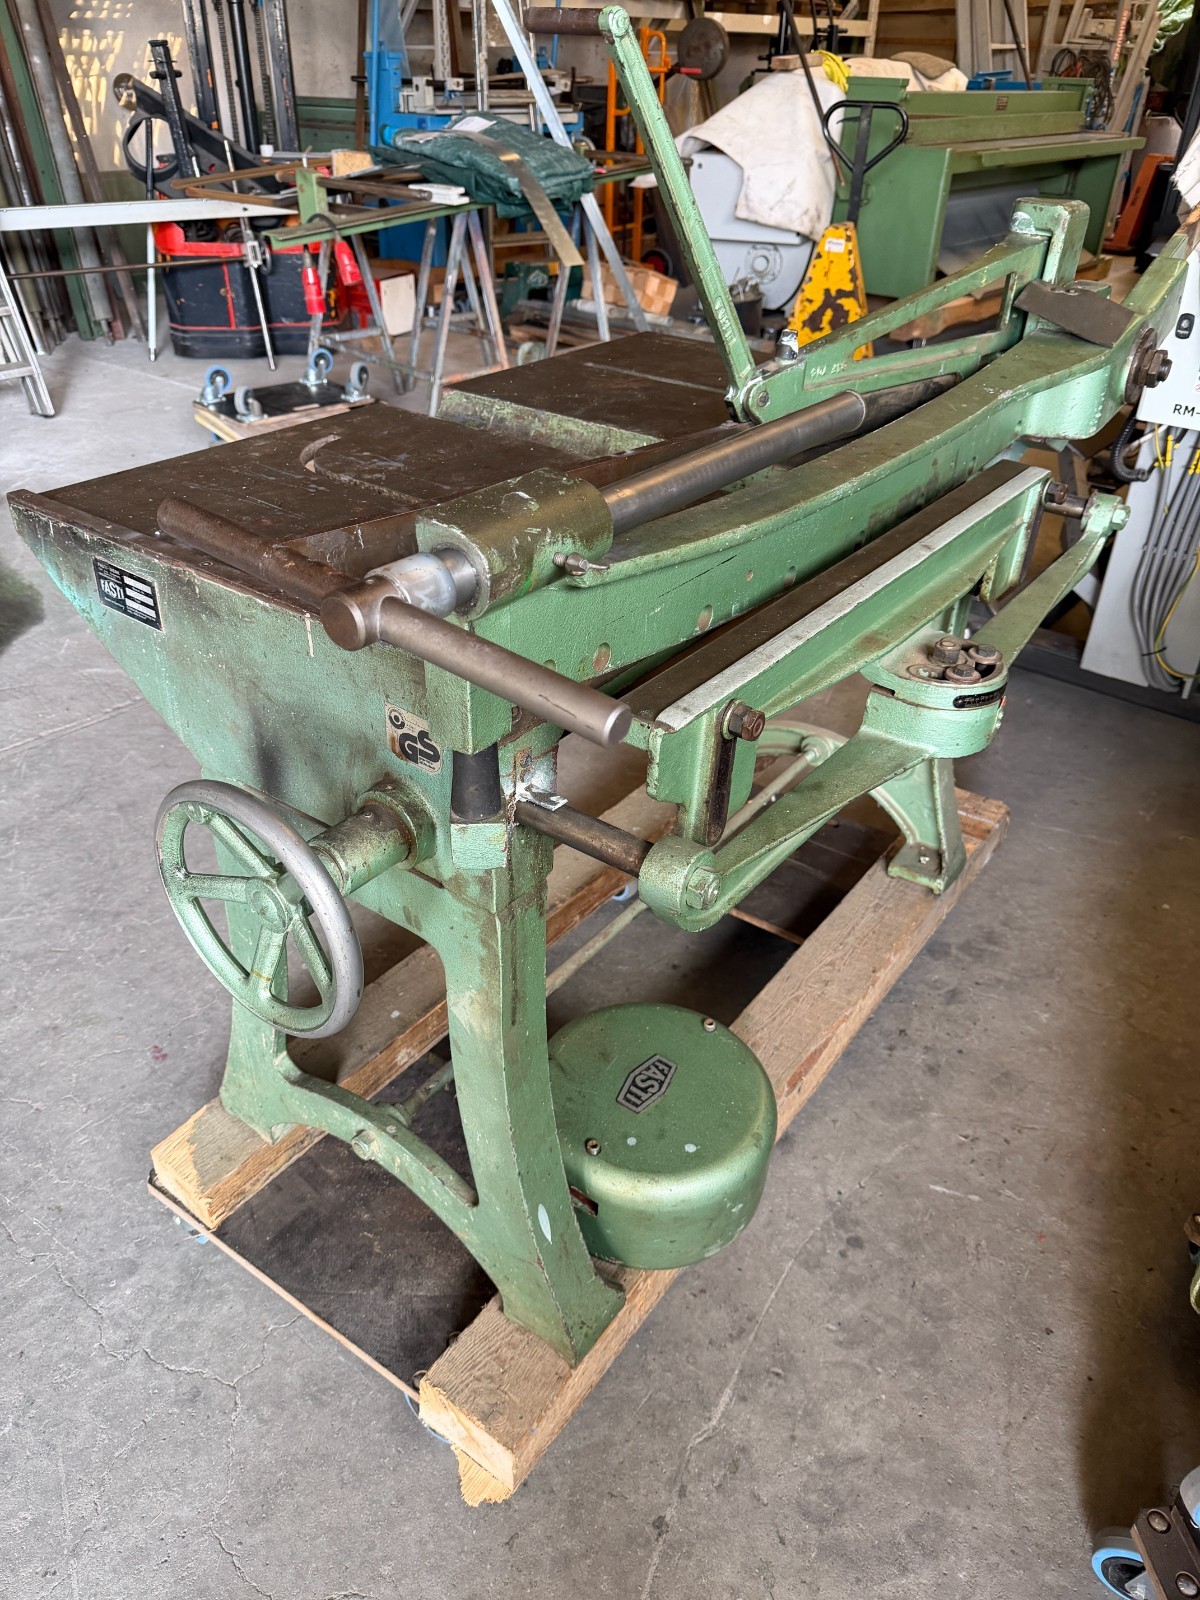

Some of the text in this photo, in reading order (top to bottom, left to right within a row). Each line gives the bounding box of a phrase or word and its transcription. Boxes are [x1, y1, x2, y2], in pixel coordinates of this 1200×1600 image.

[100, 578, 125, 600] FASTI
[399, 729, 441, 765] GS
[625, 1060, 670, 1105] FASTI
